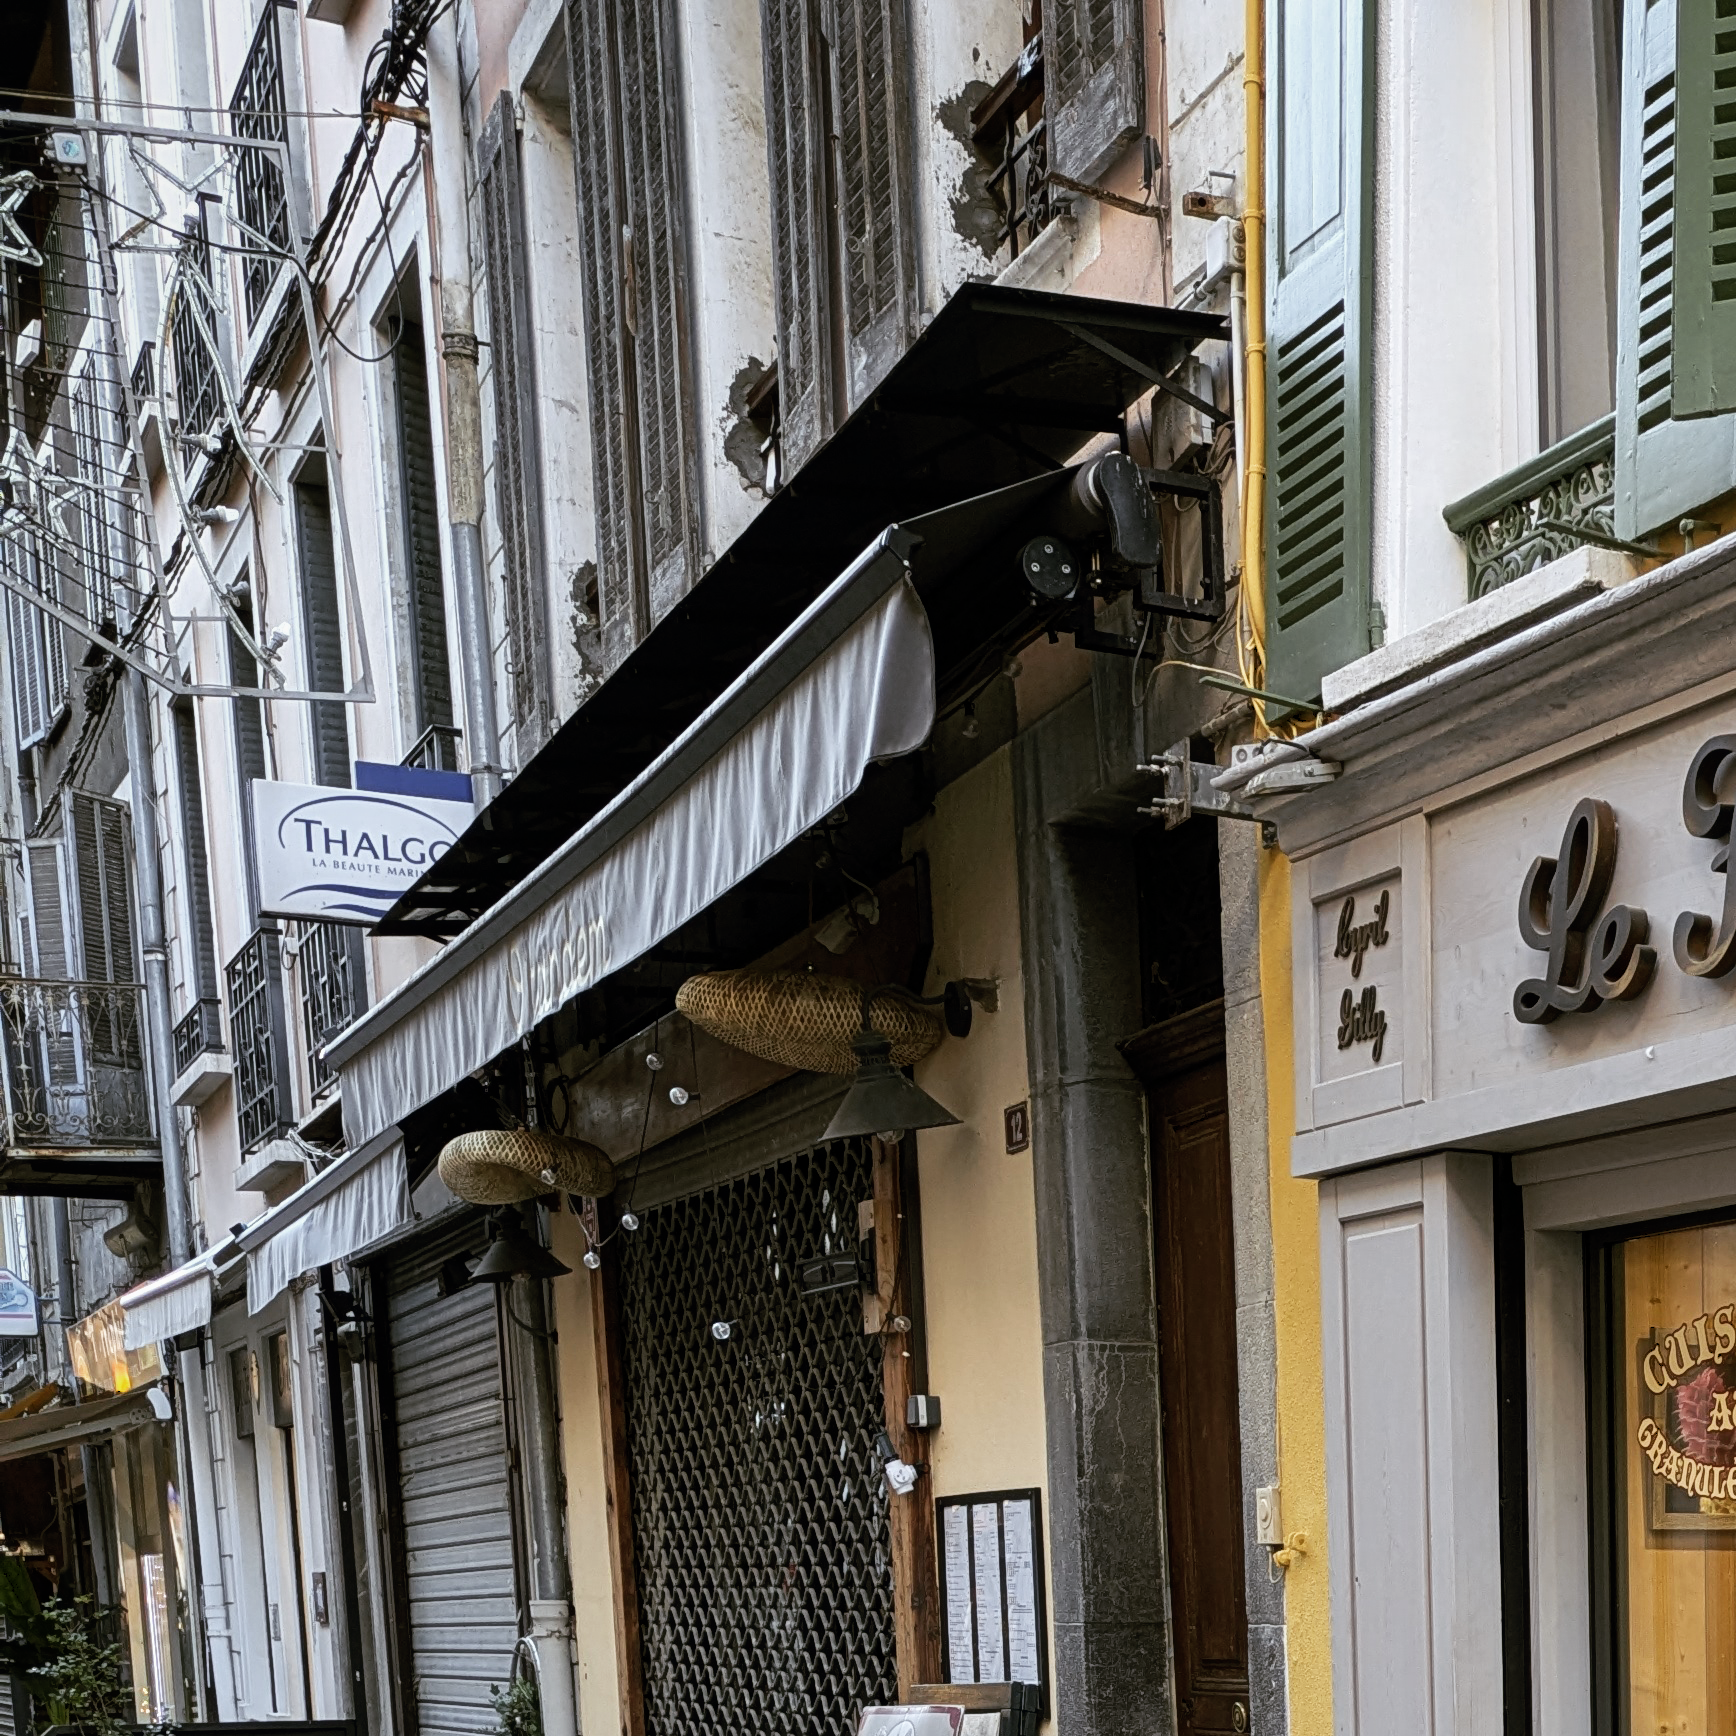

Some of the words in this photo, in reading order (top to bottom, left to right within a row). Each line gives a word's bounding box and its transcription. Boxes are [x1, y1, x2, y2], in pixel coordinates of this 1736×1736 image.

[312, 858, 327, 868] LA
[333, 859, 380, 874] BEAUTE
[1334, 889, 1390, 979] Cyril
[1513, 797, 1658, 1024] Le
[1011, 1112, 1023, 1144] 12
